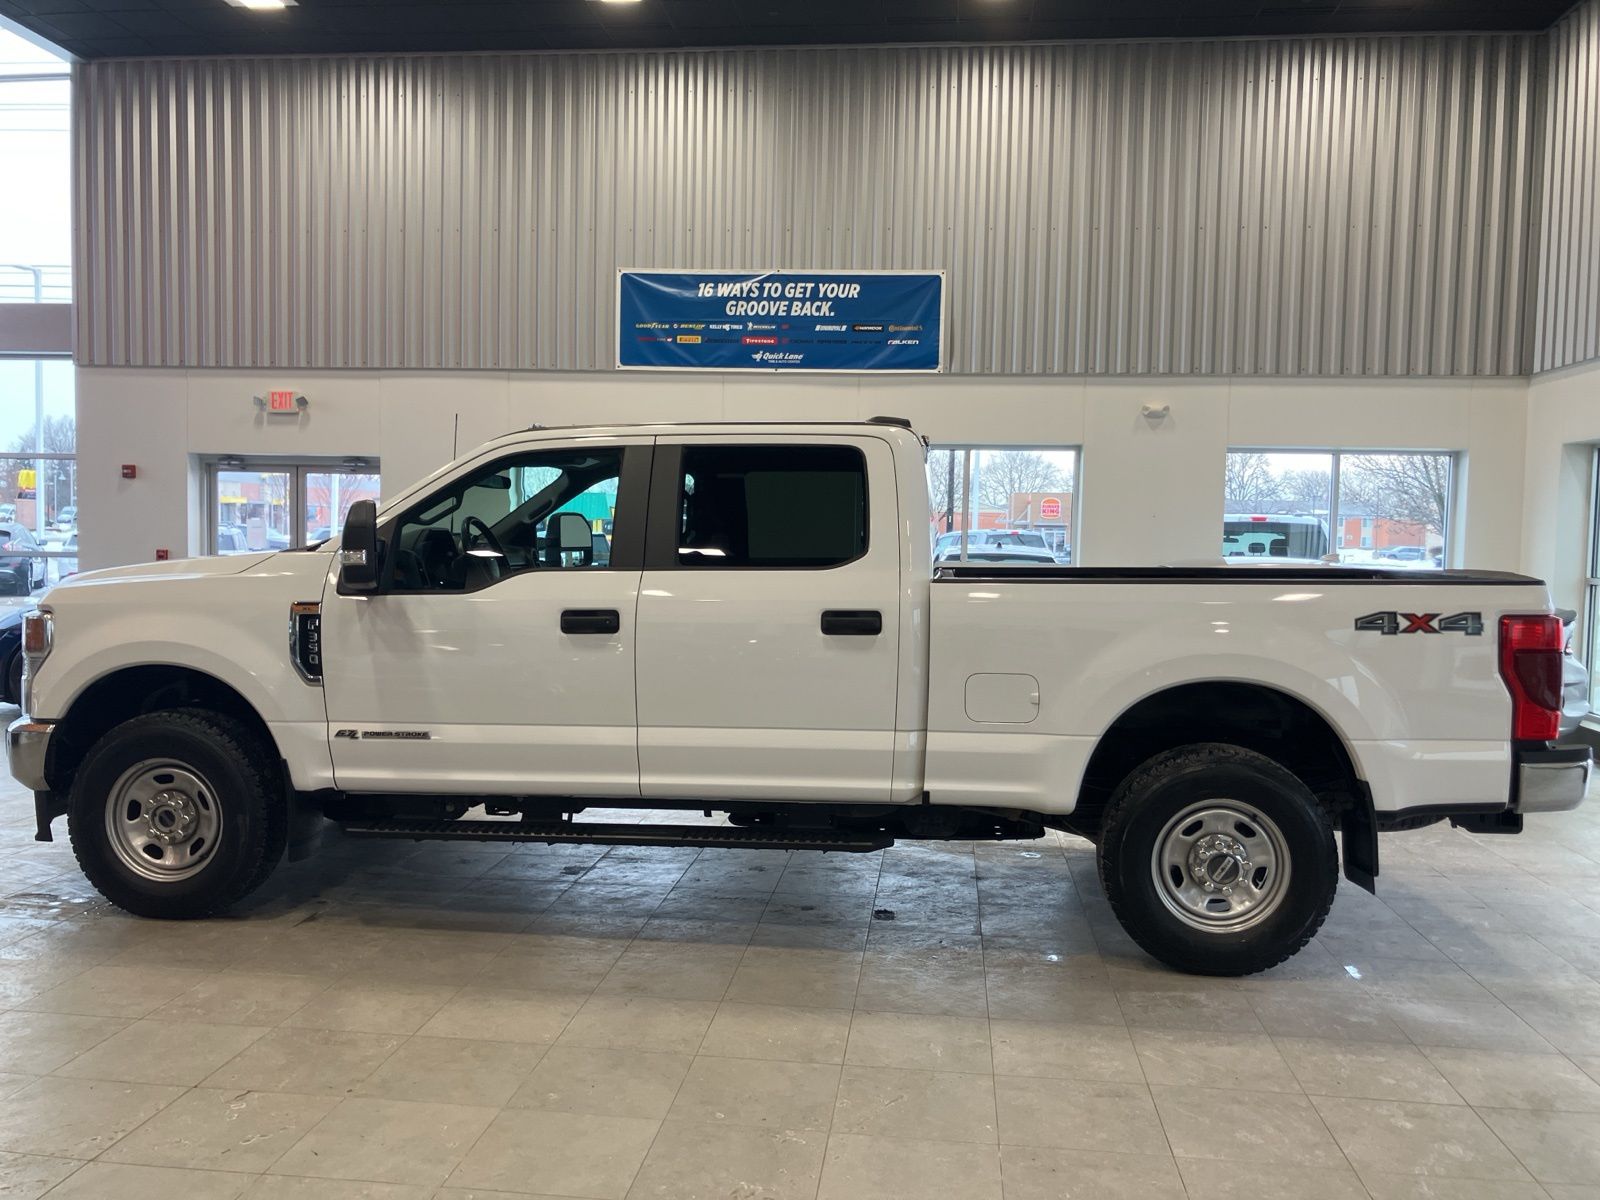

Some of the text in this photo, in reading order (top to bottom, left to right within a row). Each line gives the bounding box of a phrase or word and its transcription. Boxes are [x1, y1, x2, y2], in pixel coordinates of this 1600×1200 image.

[697, 282, 861, 299] 16 WAYS TO GET YOUR
[725, 300, 835, 317] GROOVE BACK.
[763, 352, 804, 360] Quick Lane
[271, 391, 293, 409] EXIT
